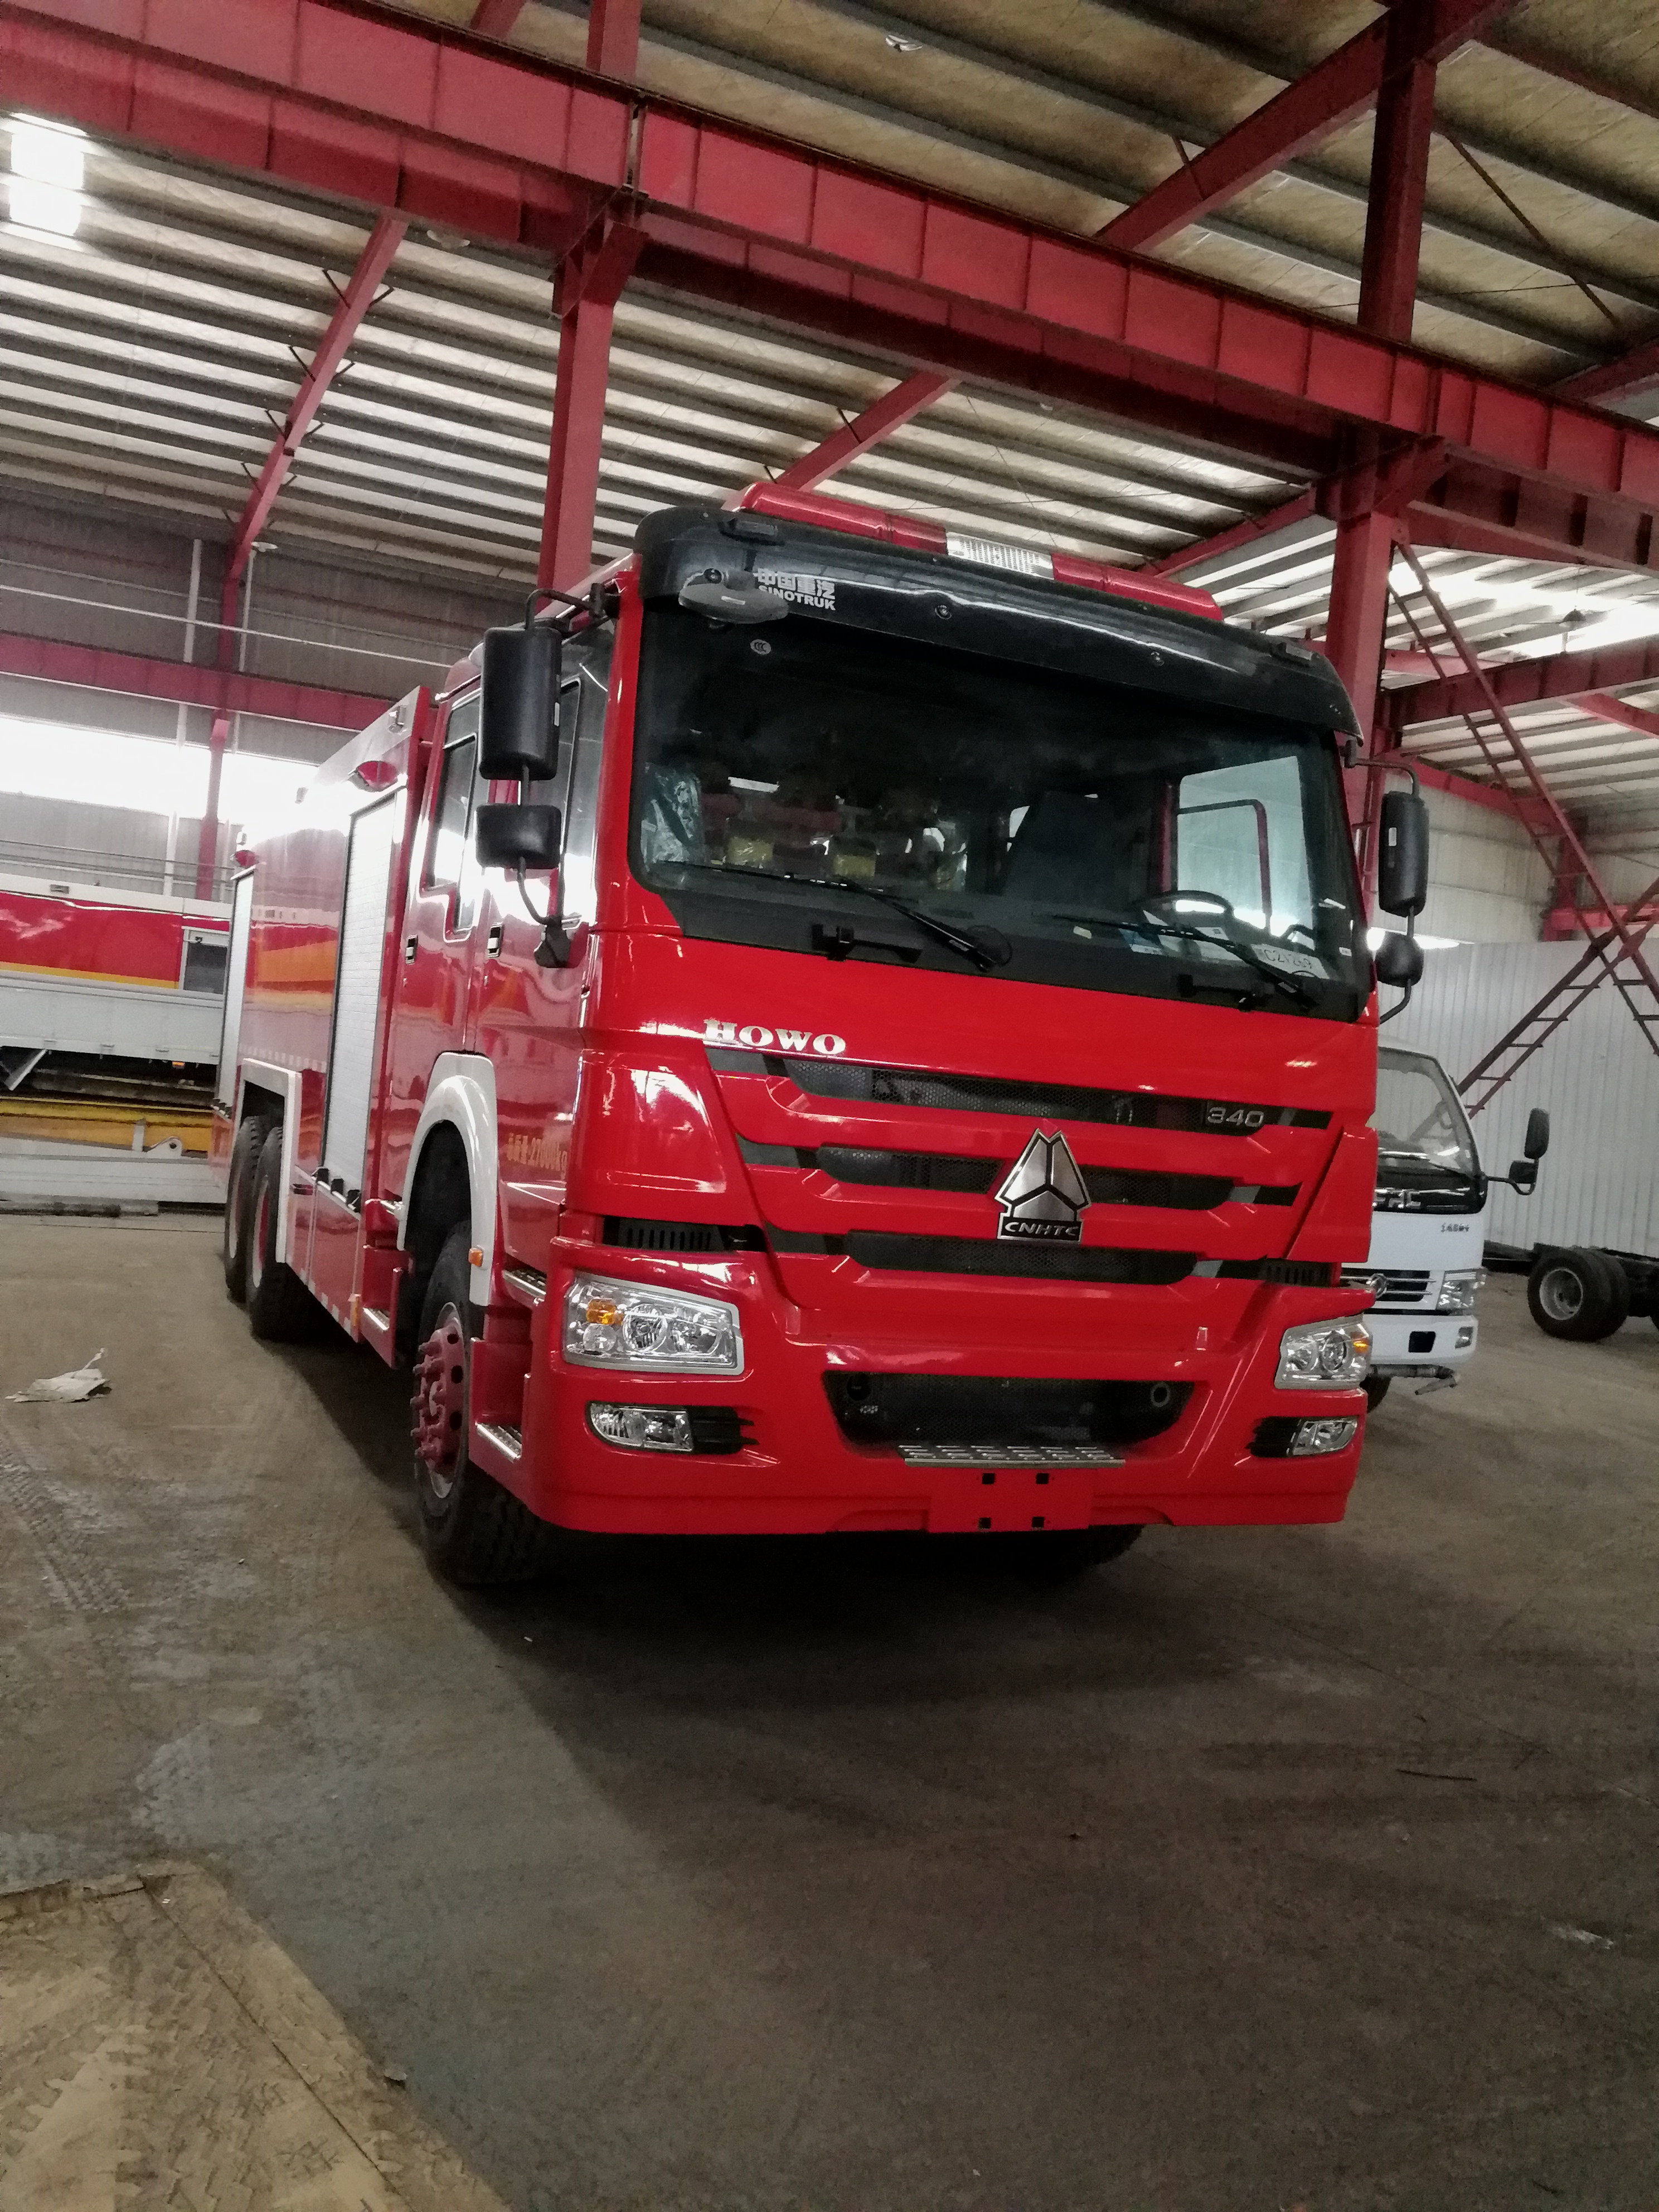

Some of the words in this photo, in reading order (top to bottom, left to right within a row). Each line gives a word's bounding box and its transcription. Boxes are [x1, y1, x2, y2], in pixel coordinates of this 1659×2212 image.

[757, 567, 836, 600] 中国重汽
[758, 585, 836, 611] SINOTRUK
[703, 1018, 846, 1055] HOWO
[1207, 1107, 1264, 1128] 340
[1005, 1221, 1079, 1236] CNHTC
